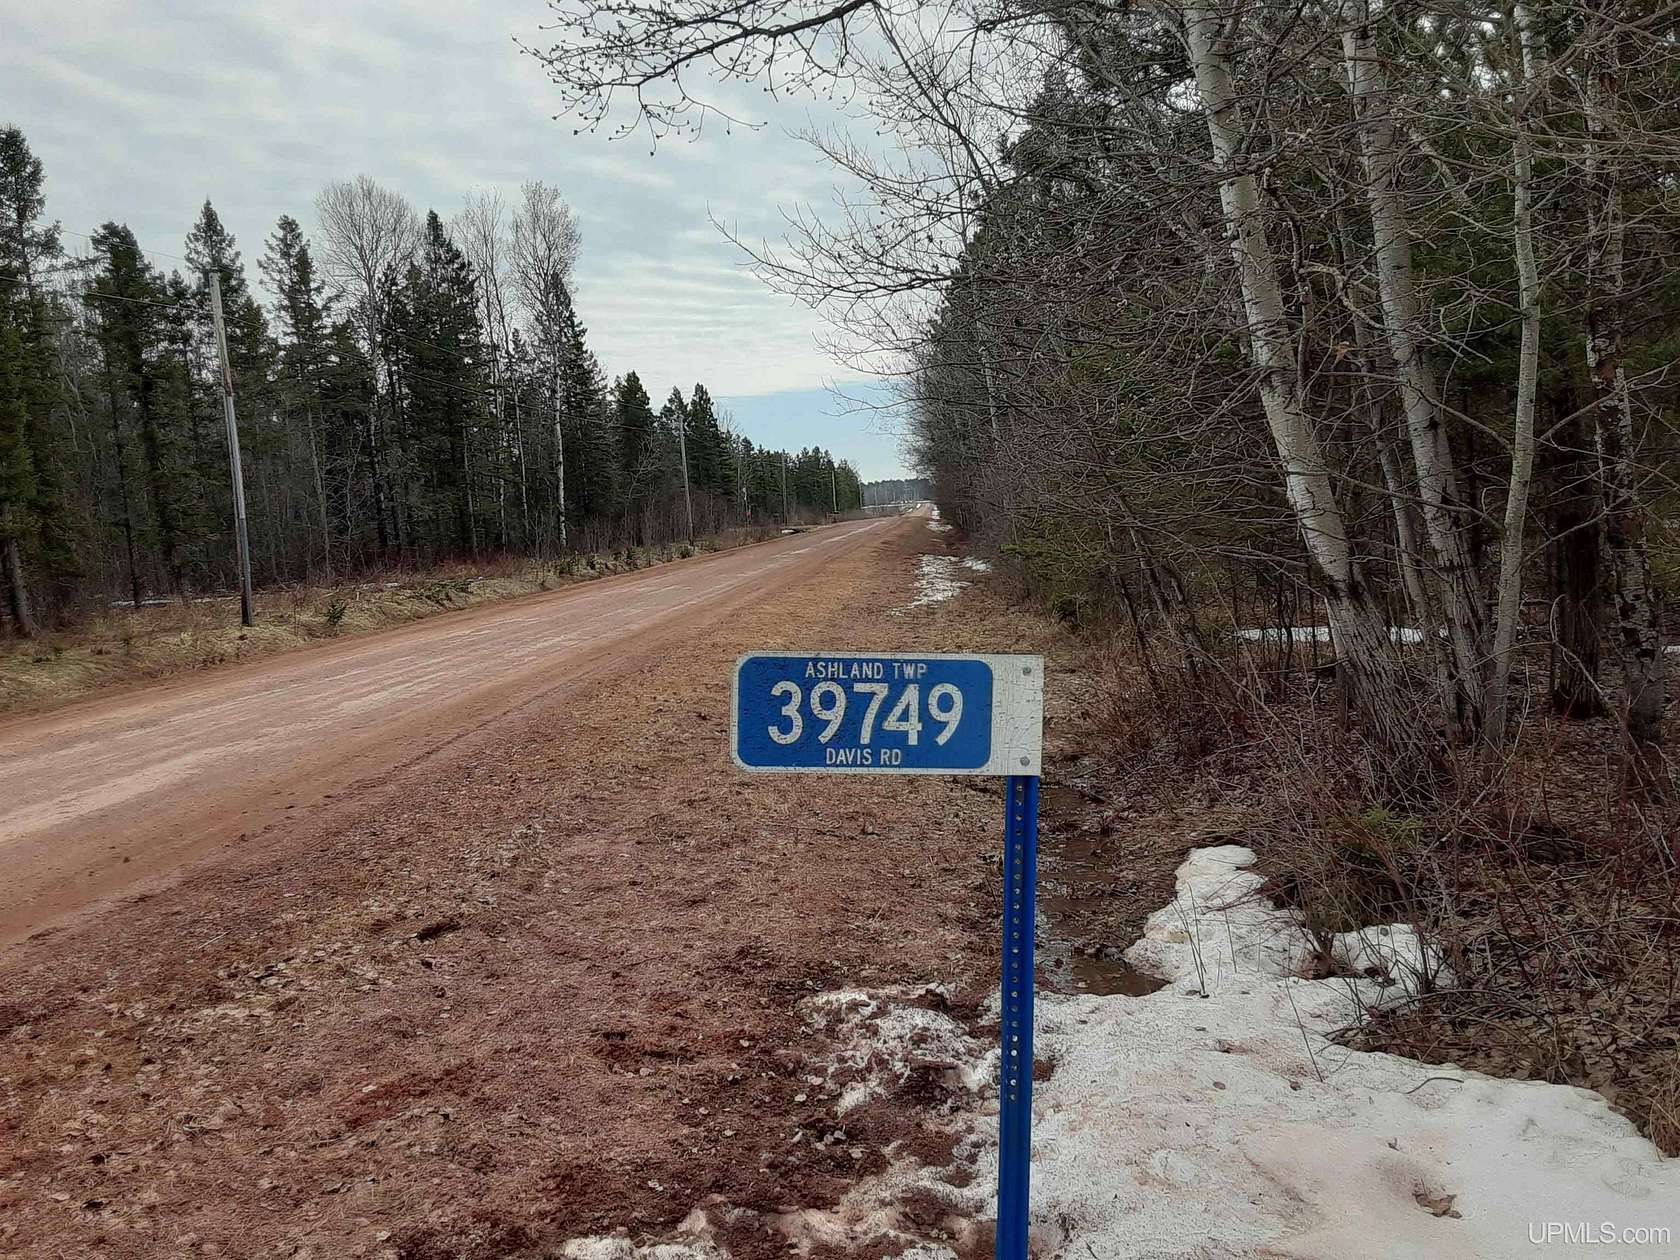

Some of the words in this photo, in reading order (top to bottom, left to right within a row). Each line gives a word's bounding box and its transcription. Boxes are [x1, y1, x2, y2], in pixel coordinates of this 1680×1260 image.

[805, 662, 883, 679] ASHLAND
[893, 663, 927, 679] TWP
[768, 680, 963, 746] 39749
[826, 748, 872, 765] DAVIS
[880, 749, 901, 765] RD
